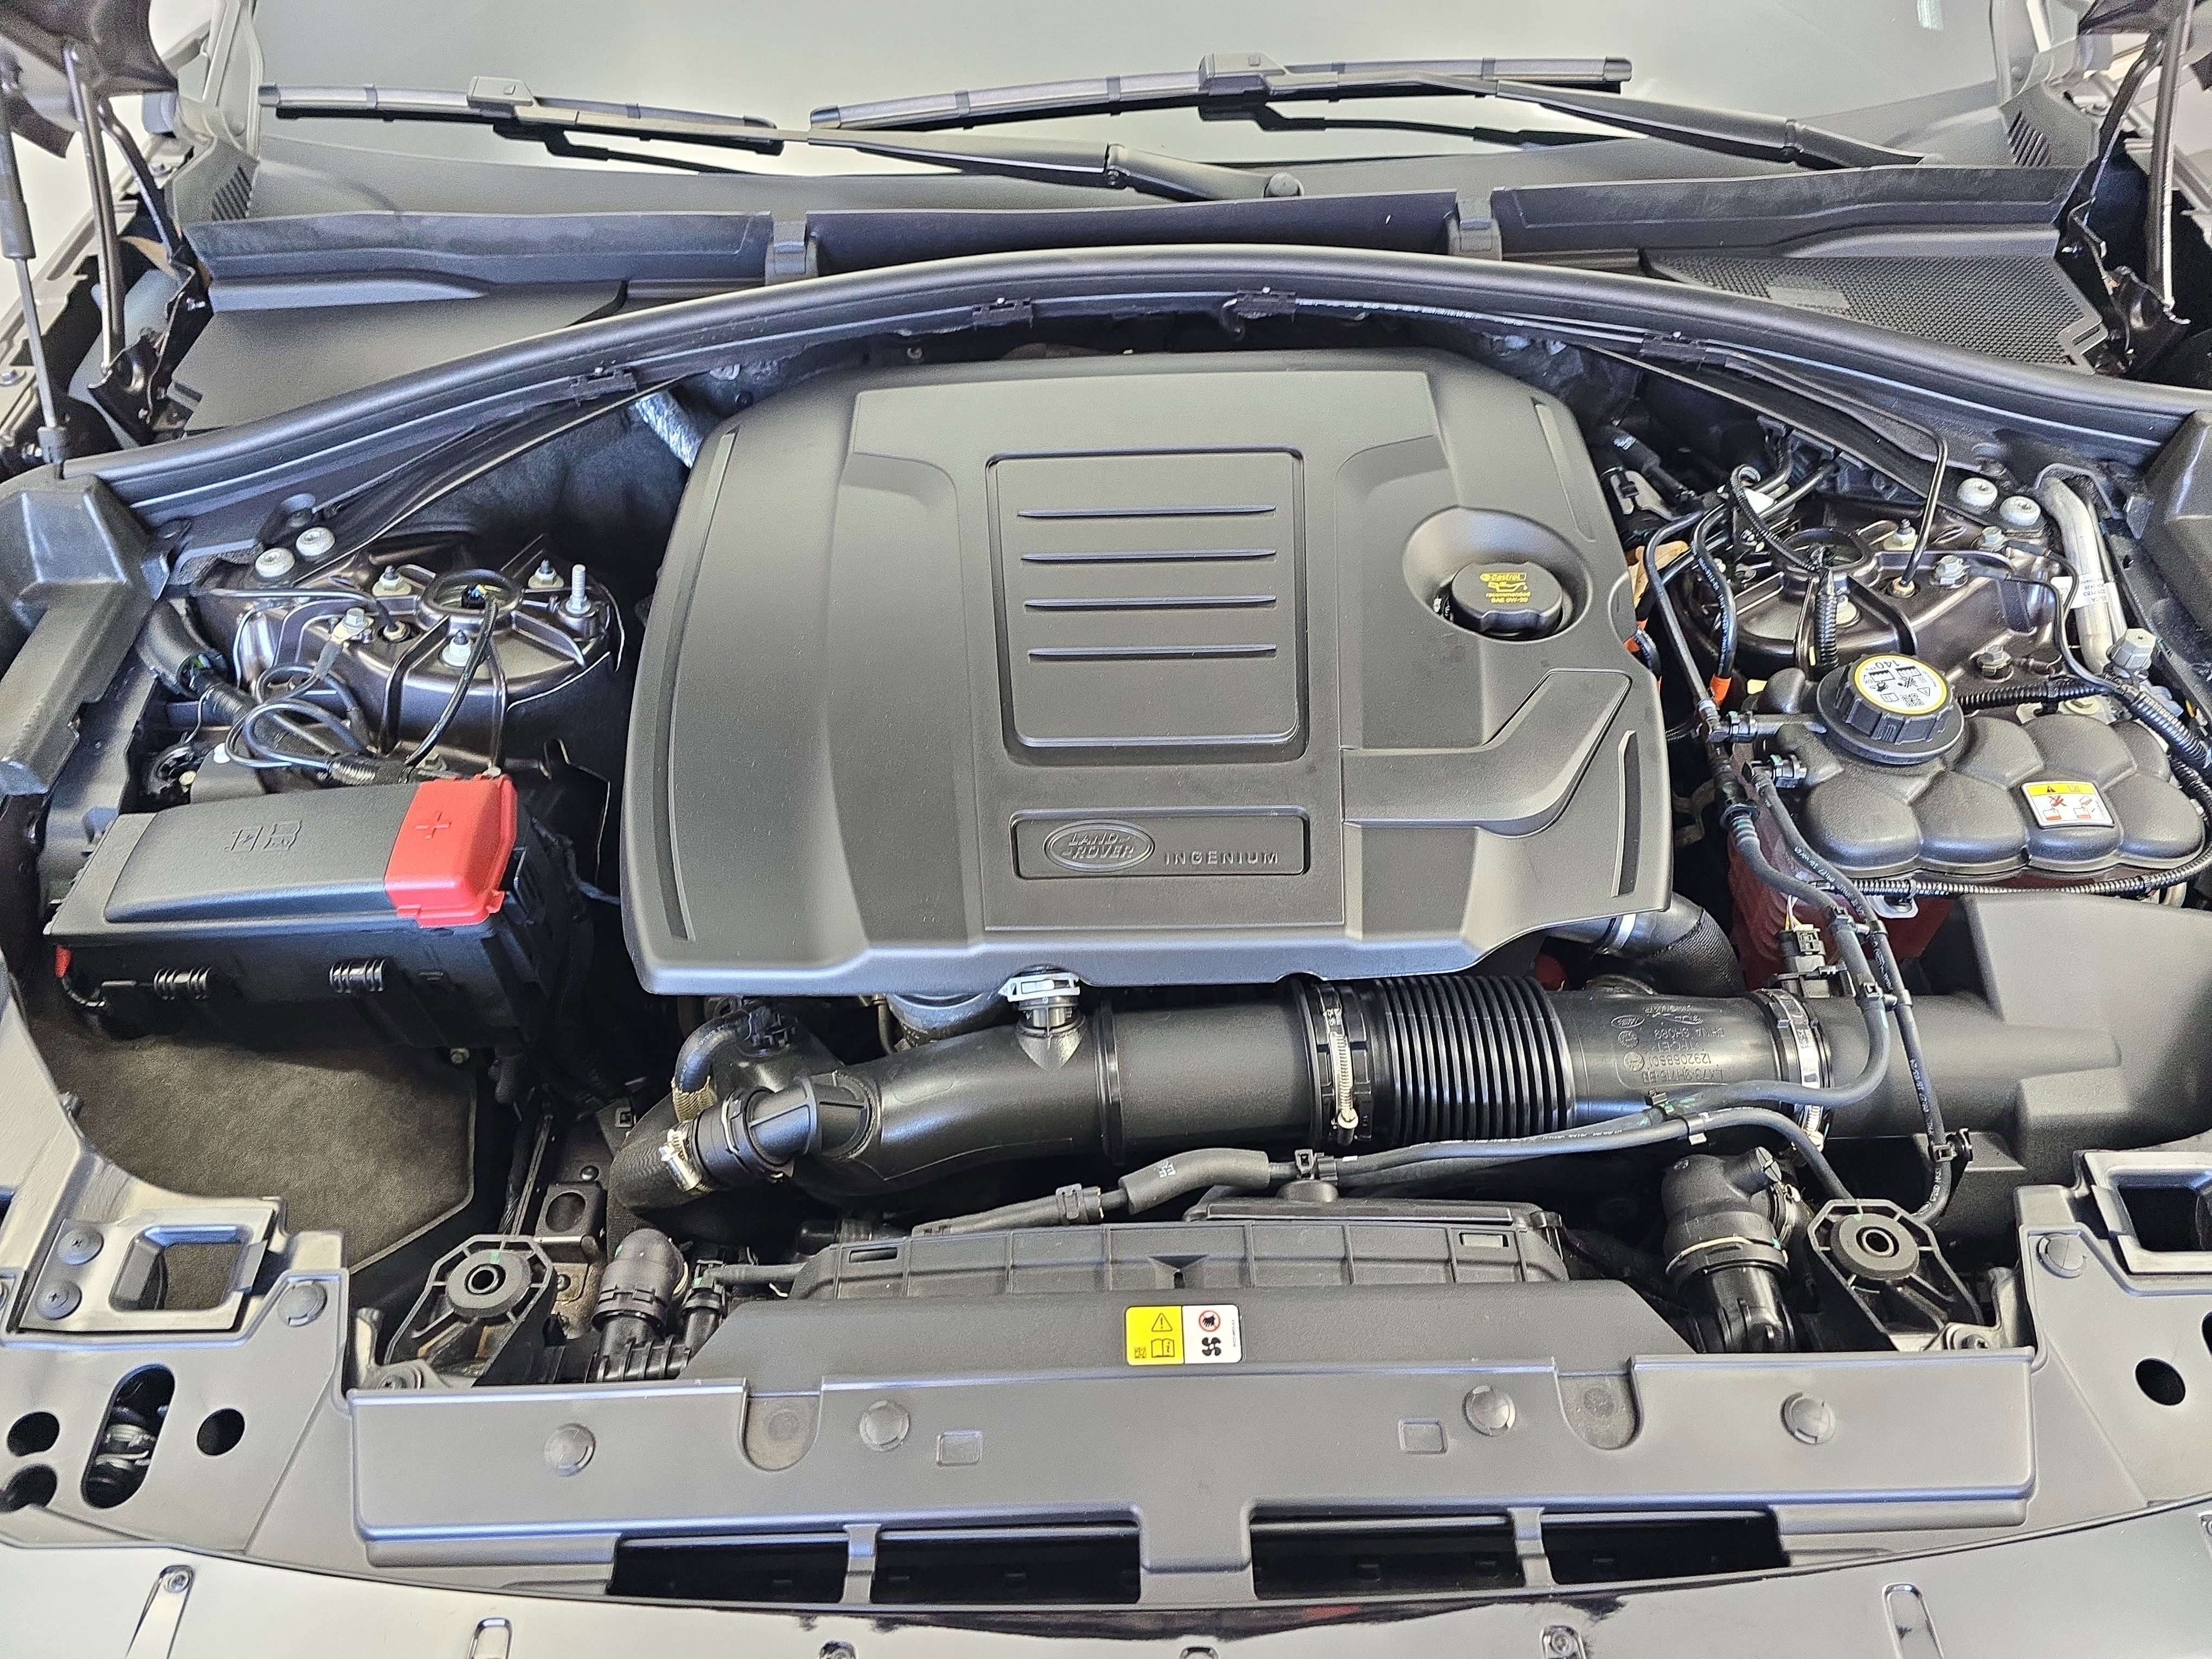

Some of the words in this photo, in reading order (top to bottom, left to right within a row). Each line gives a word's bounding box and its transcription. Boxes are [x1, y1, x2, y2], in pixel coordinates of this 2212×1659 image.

[1491, 573, 1520, 581] Castrol
[1874, 659, 1900, 669] 140
[1069, 832, 1119, 846] LAND
[1072, 844, 1135, 859] ROVER
[1165, 851, 1279, 866] INGENIUM
